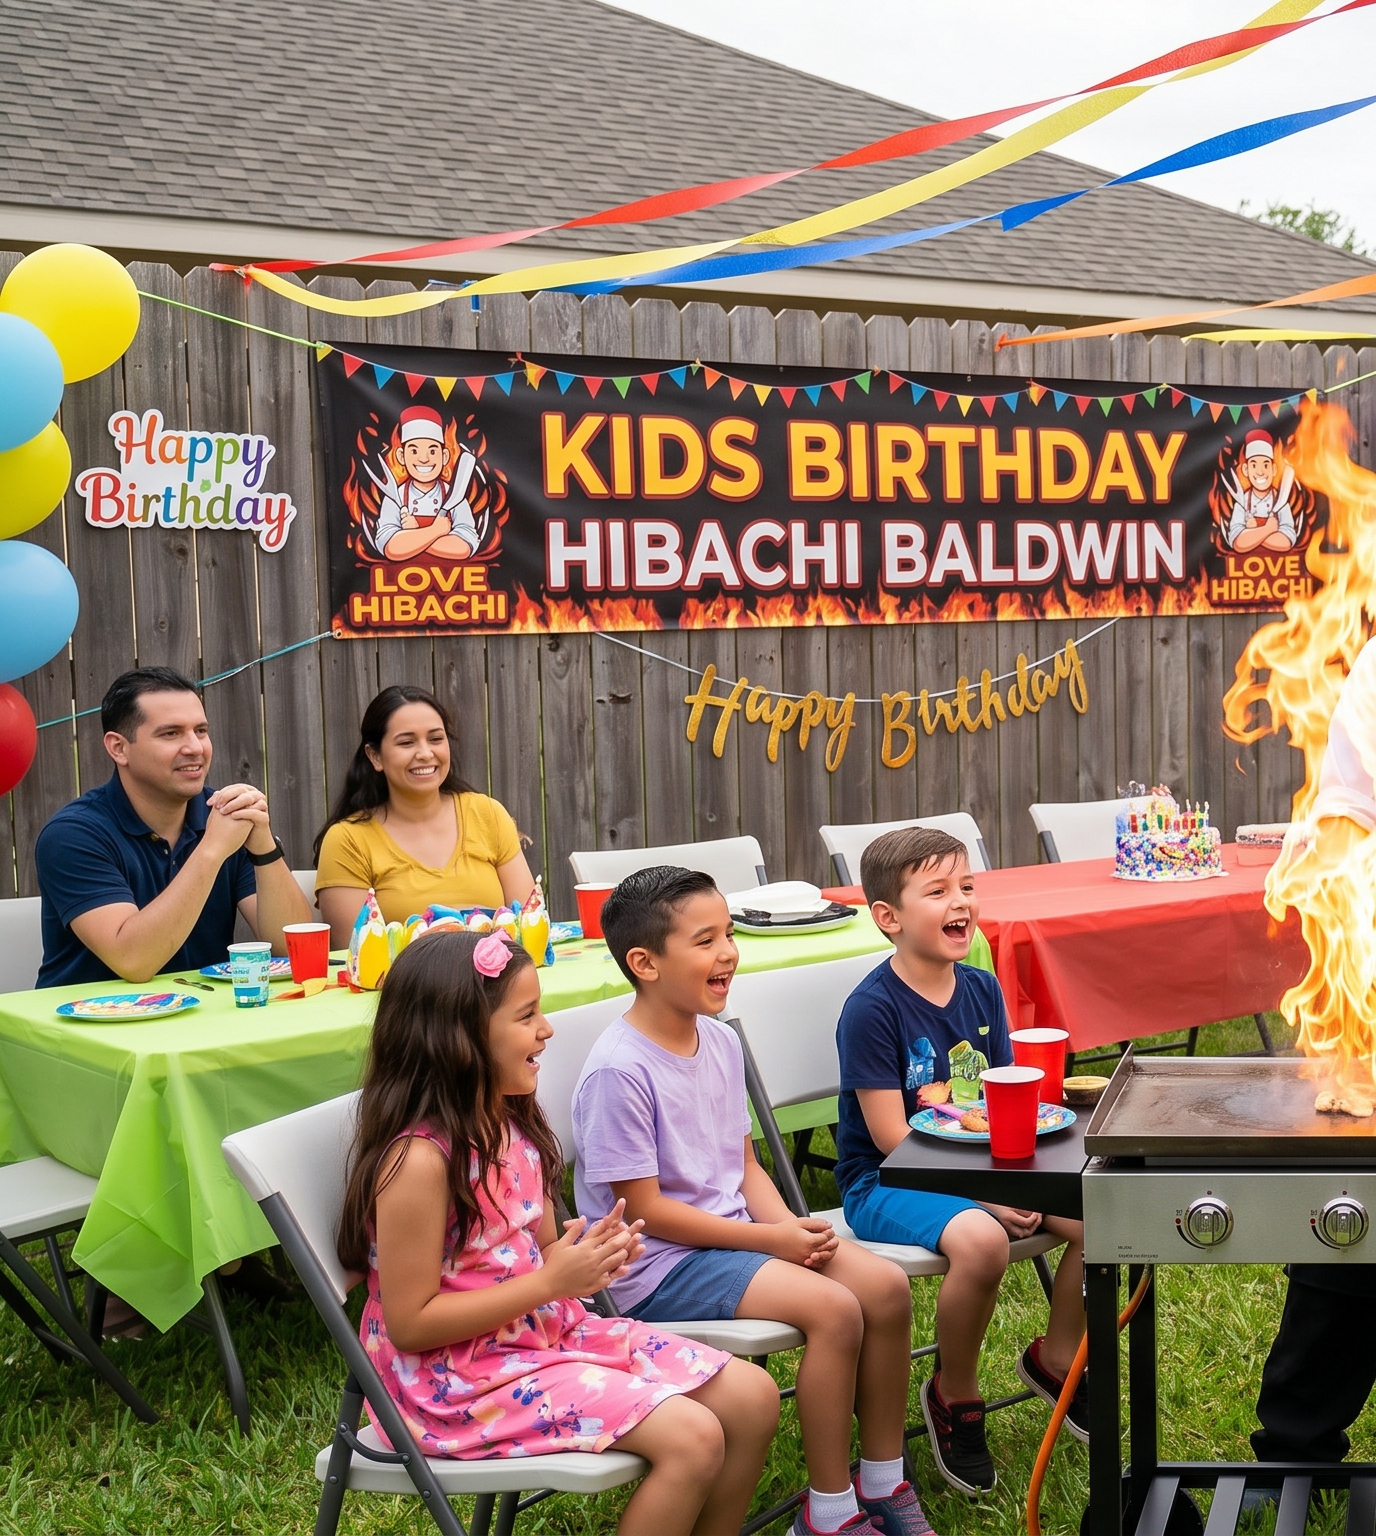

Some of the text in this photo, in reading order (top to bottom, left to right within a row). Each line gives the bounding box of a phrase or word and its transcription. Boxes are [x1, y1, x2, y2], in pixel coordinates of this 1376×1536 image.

[113, 414, 272, 488] Happy
[542, 413, 1187, 503] KIDS BIRTHDAY
[80, 472, 293, 548] Birthday
[374, 565, 488, 593] LOVE
[546, 519, 1186, 590] HIBACHI BALDWIN
[1211, 577, 1313, 601] HIBACHI
[1228, 555, 1301, 578] LOVE
[353, 594, 506, 623] HIBACHI
[684, 638, 1090, 773] Happy Birthday
